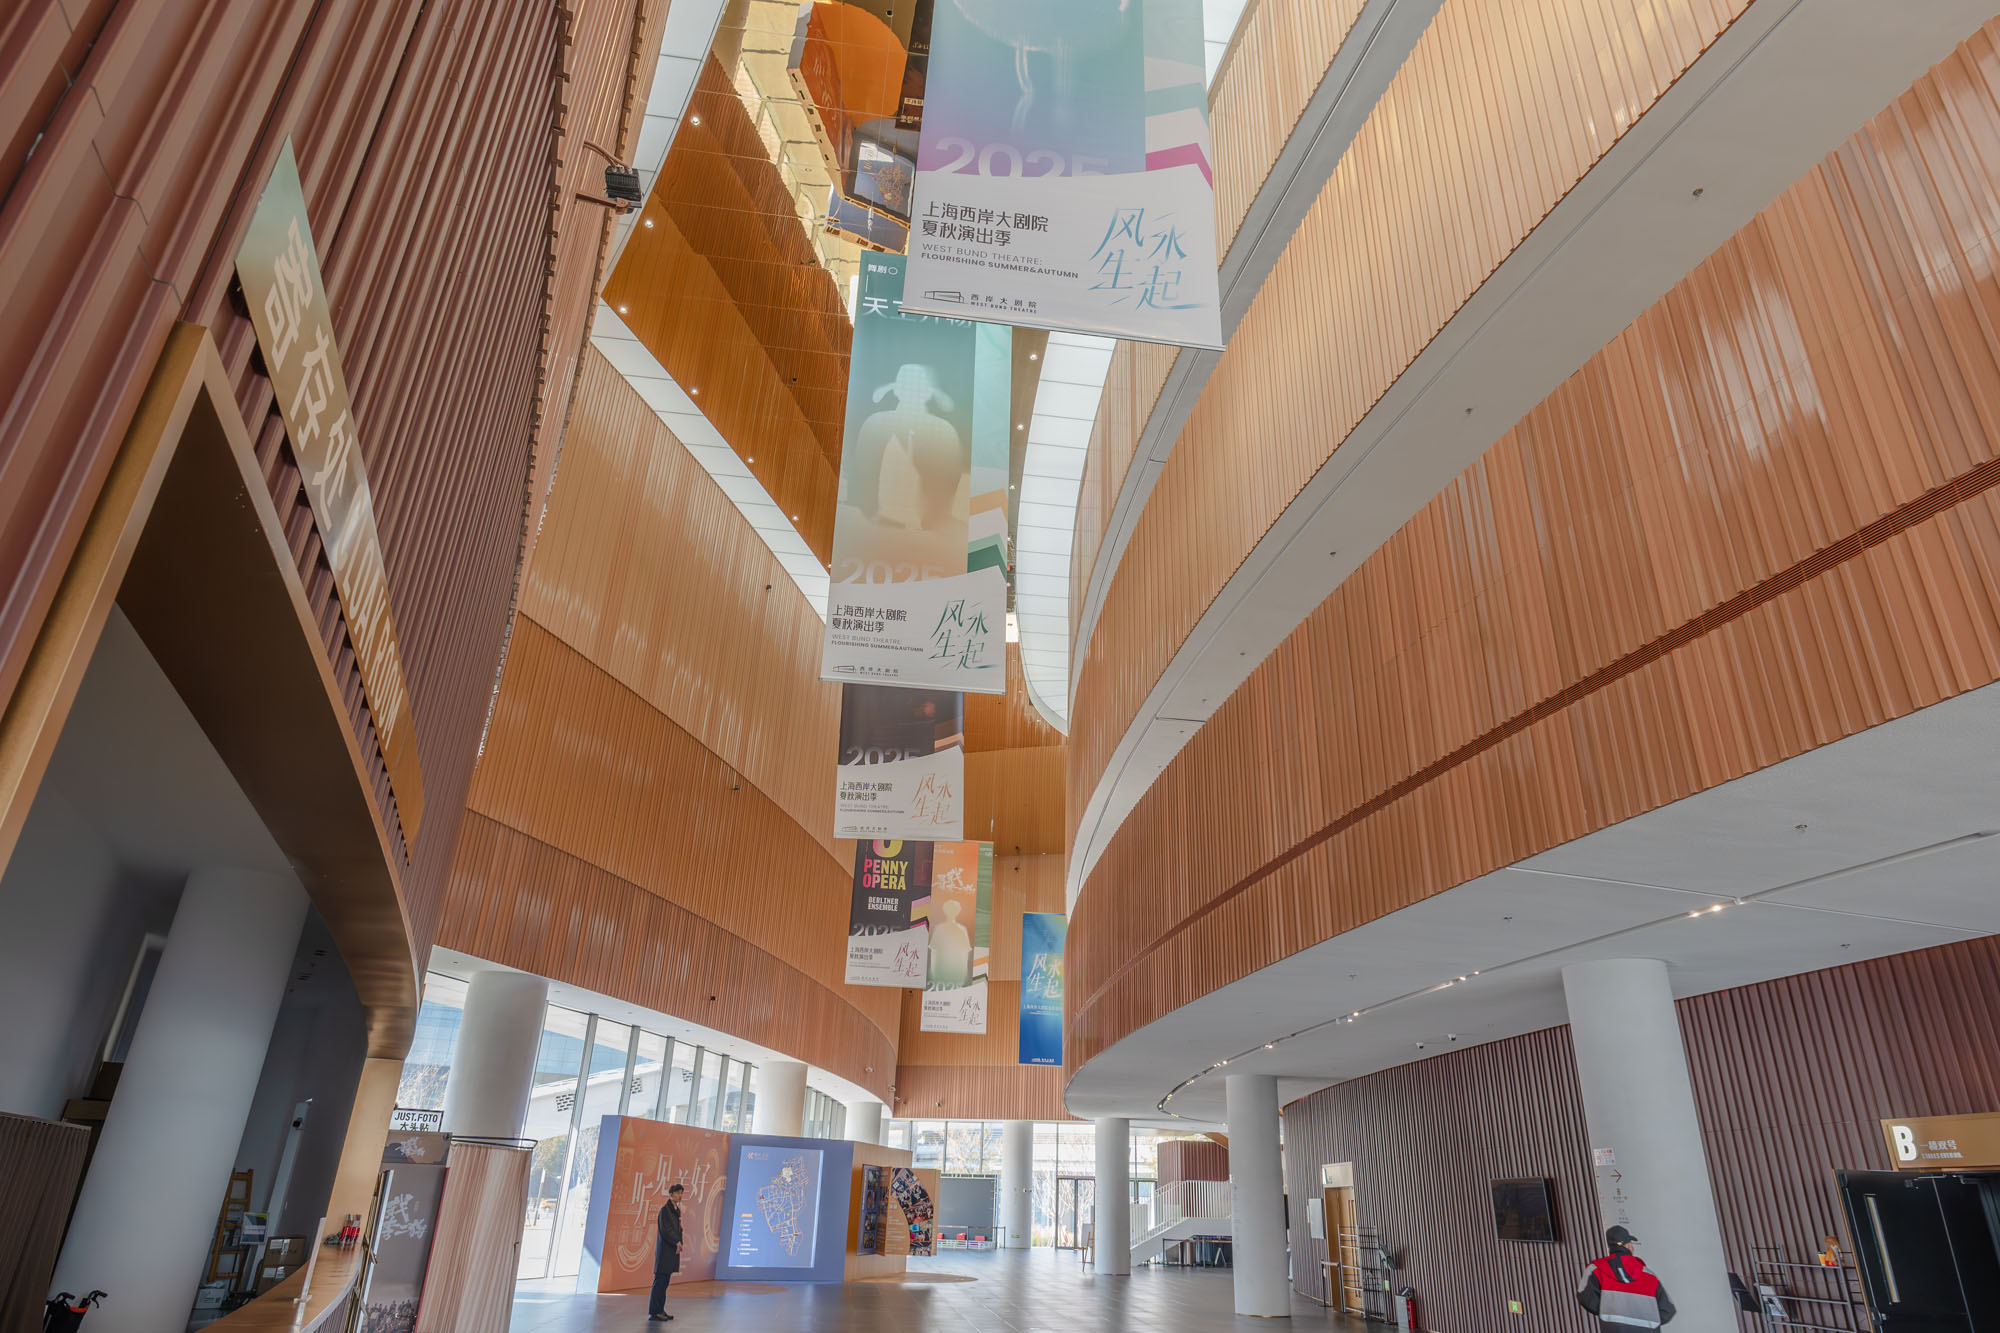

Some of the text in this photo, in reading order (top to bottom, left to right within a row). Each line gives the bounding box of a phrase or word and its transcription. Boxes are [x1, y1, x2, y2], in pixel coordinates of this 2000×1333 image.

[922, 200, 1049, 233] 上海西岸大剧院
[922, 219, 1011, 247] 夏秋演出季
[922, 243, 1043, 266] WEST BUND THEATRE:
[921, 252, 1079, 279] FLOURISHING SUMMER&AUTUMN
[971, 293, 1037, 309] 西岸大剧院
[264, 215, 352, 533] 寄存处
[335, 483, 404, 752] CLOAK ROOM
[832, 604, 908, 622] 上海西岸大剧院
[832, 617, 885, 633] 夏秋演出季
[863, 858, 909, 876] PENNY
[862, 873, 907, 890] OPERA
[868, 896, 899, 905] BERLINER
[868, 903, 898, 912] ENSEMBLE
[395, 1112, 438, 1123] JUST.FOTO
[1892, 1125, 1917, 1161] B
